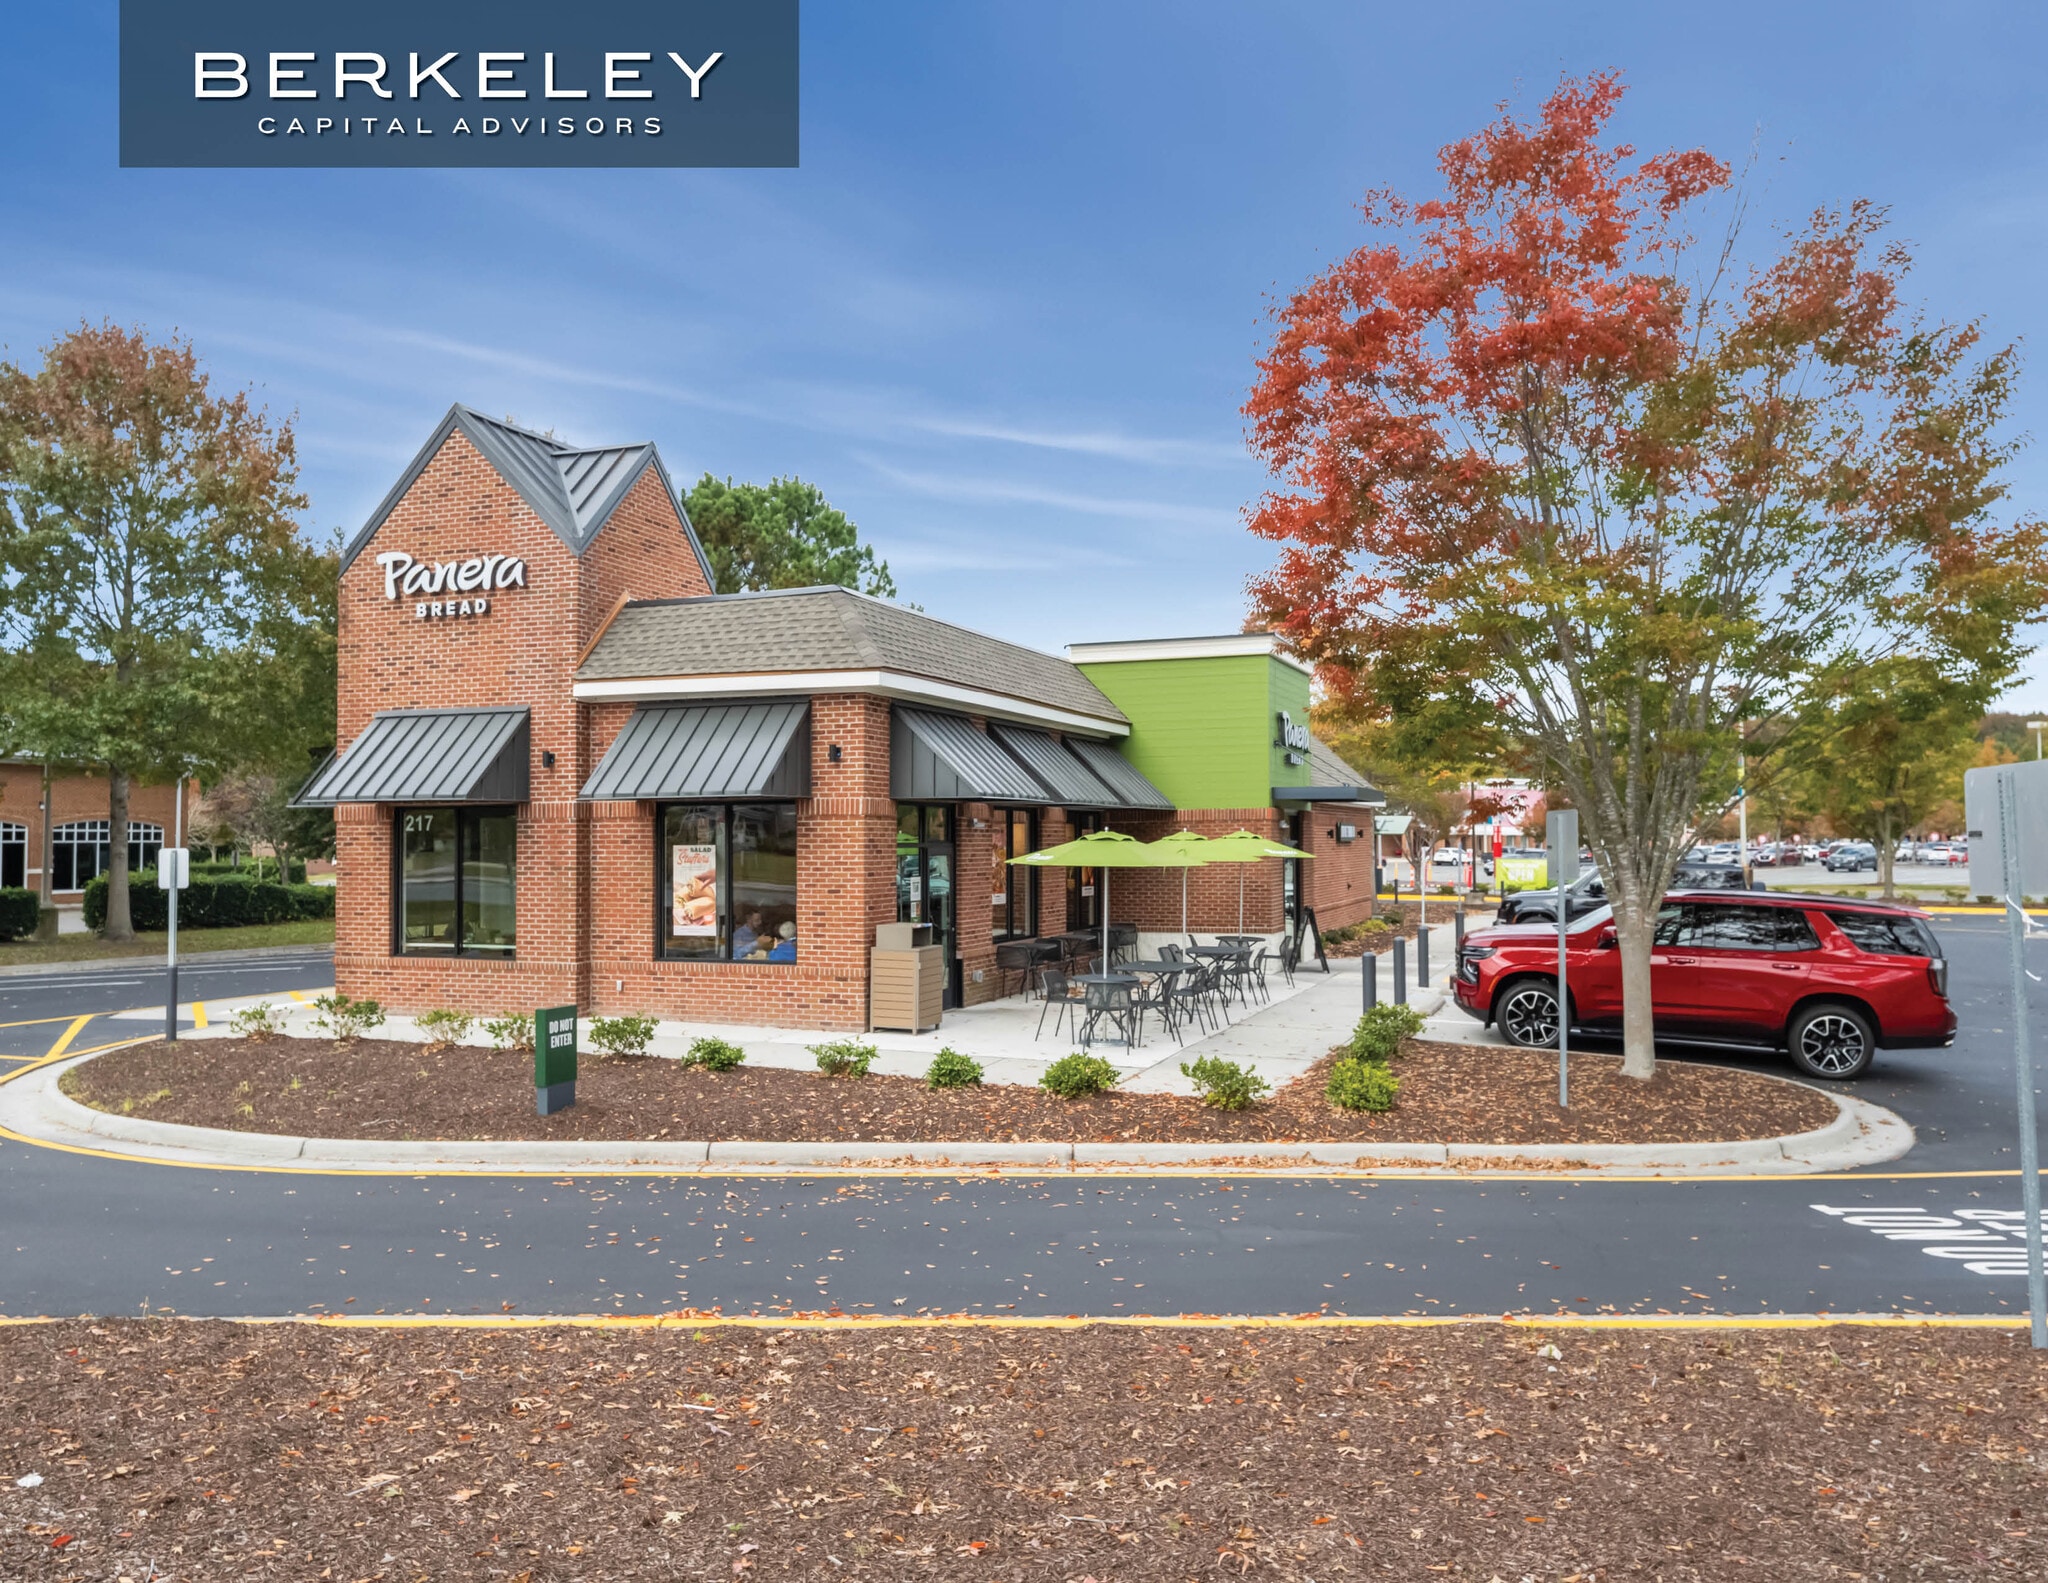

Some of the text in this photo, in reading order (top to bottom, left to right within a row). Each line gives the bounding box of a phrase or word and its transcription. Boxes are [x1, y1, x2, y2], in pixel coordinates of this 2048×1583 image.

[376, 551, 525, 600] Panera
[416, 598, 487, 618] BREAD
[405, 815, 434, 832] 217
[549, 1018, 574, 1035] DO NOT
[550, 1032, 573, 1049] ENTER
